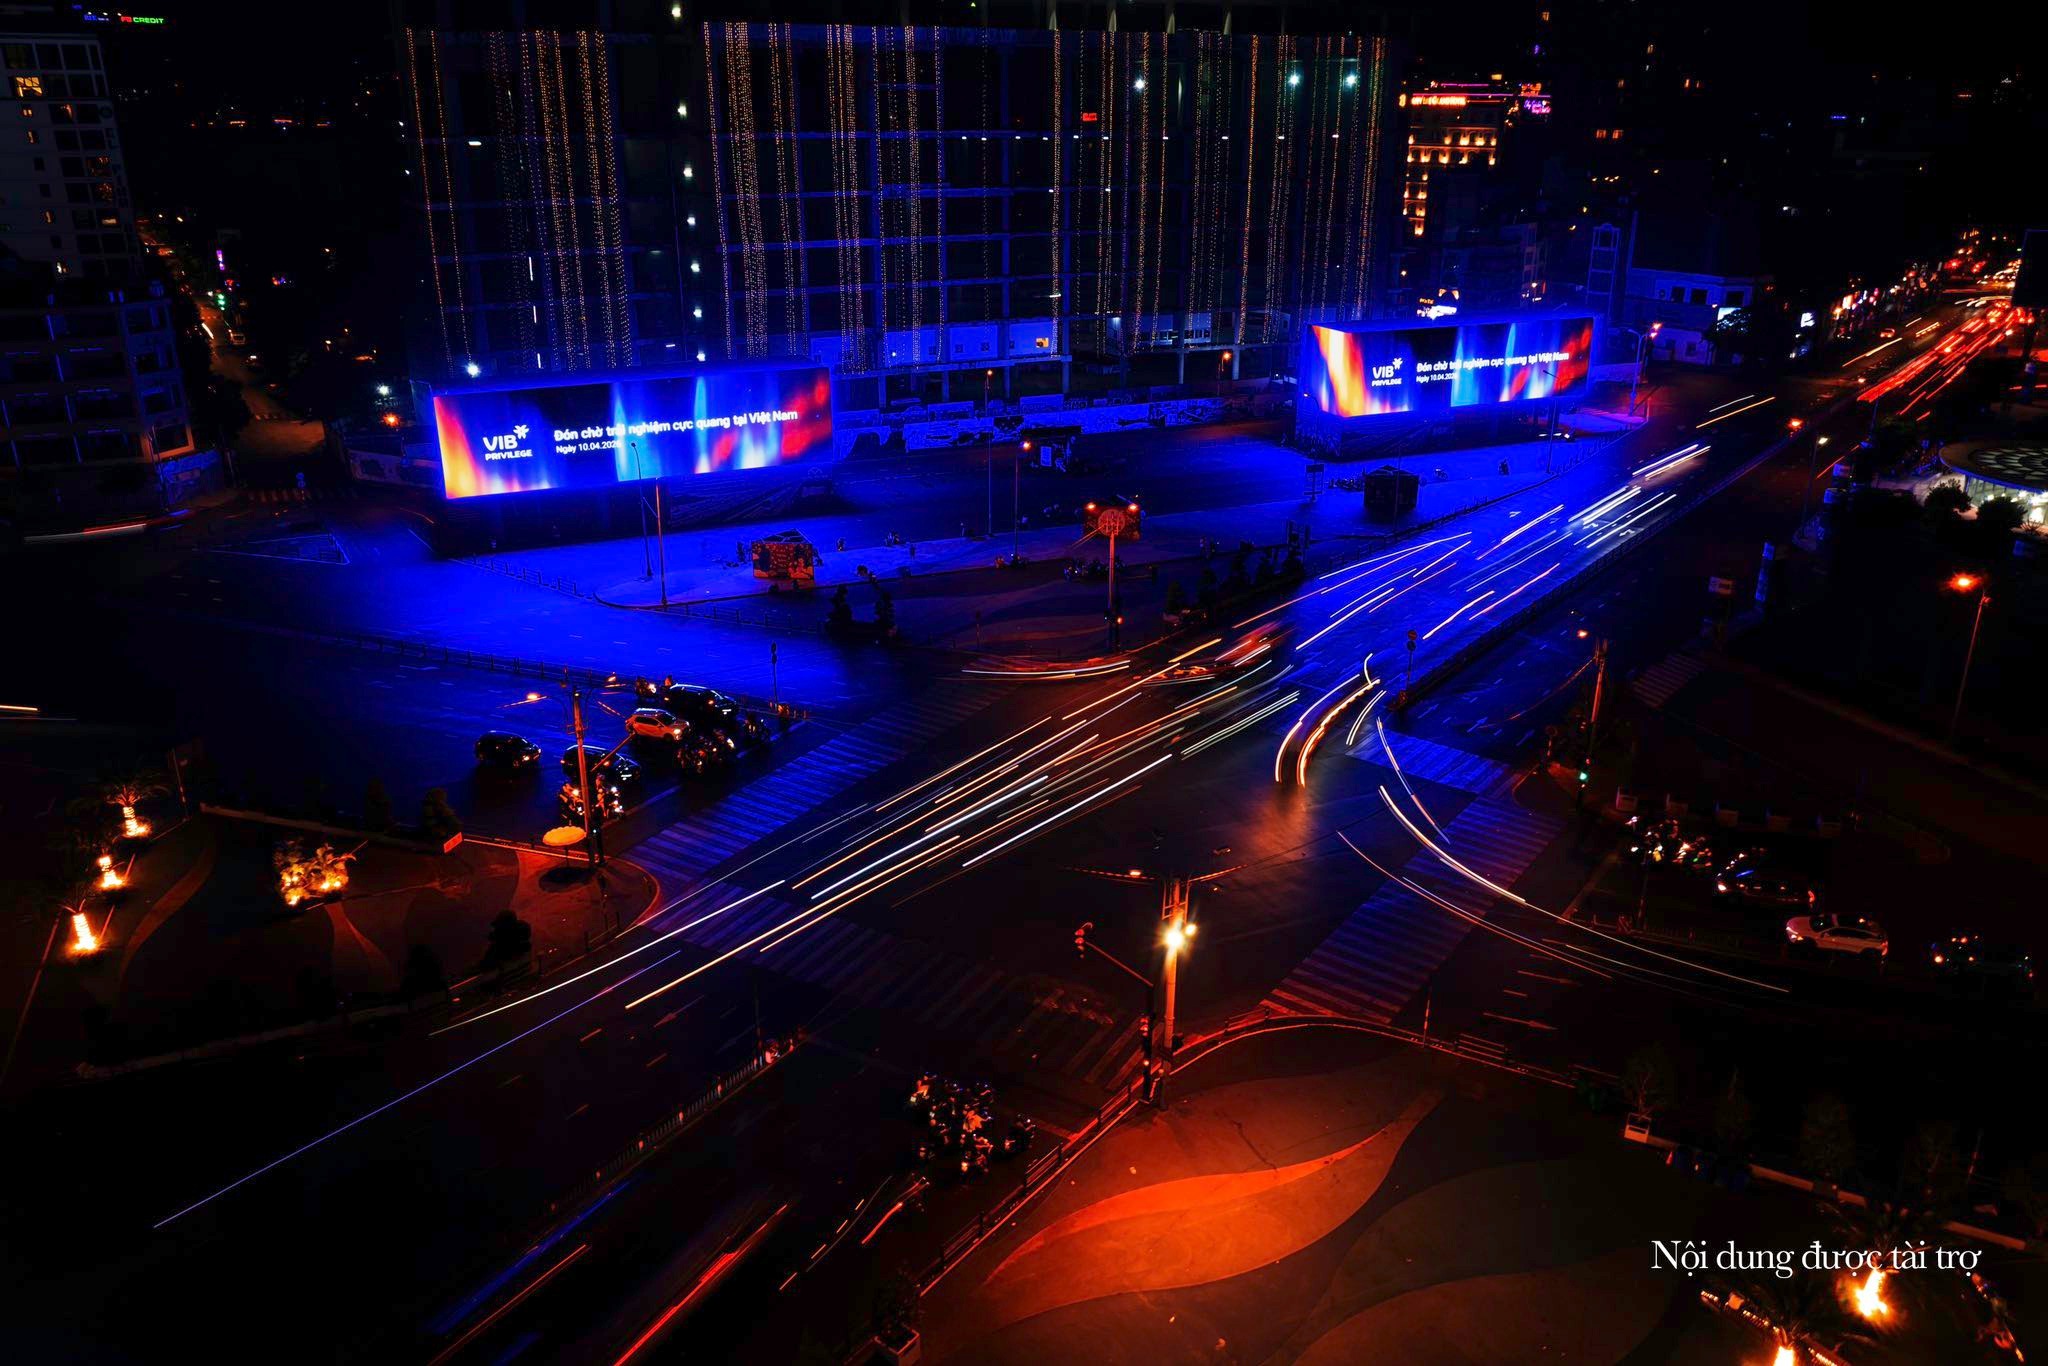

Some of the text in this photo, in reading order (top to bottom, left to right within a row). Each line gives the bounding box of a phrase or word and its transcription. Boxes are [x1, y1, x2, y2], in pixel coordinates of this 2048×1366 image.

[133, 16, 164, 24] CREDIT
[1372, 365, 1394, 379] VIB
[1371, 378, 1402, 387] PRIVILEGE
[553, 429, 579, 442] Đón
[581, 426, 604, 440] chờ
[628, 420, 671, 437] nghiệm
[672, 419, 693, 433] cực
[695, 415, 731, 431] quang
[748, 410, 771, 425] Việt
[772, 410, 799, 422] Nam
[483, 434, 518, 451] VIB
[485, 449, 533, 461] PRIVILEGE
[556, 444, 577, 455] Ngày
